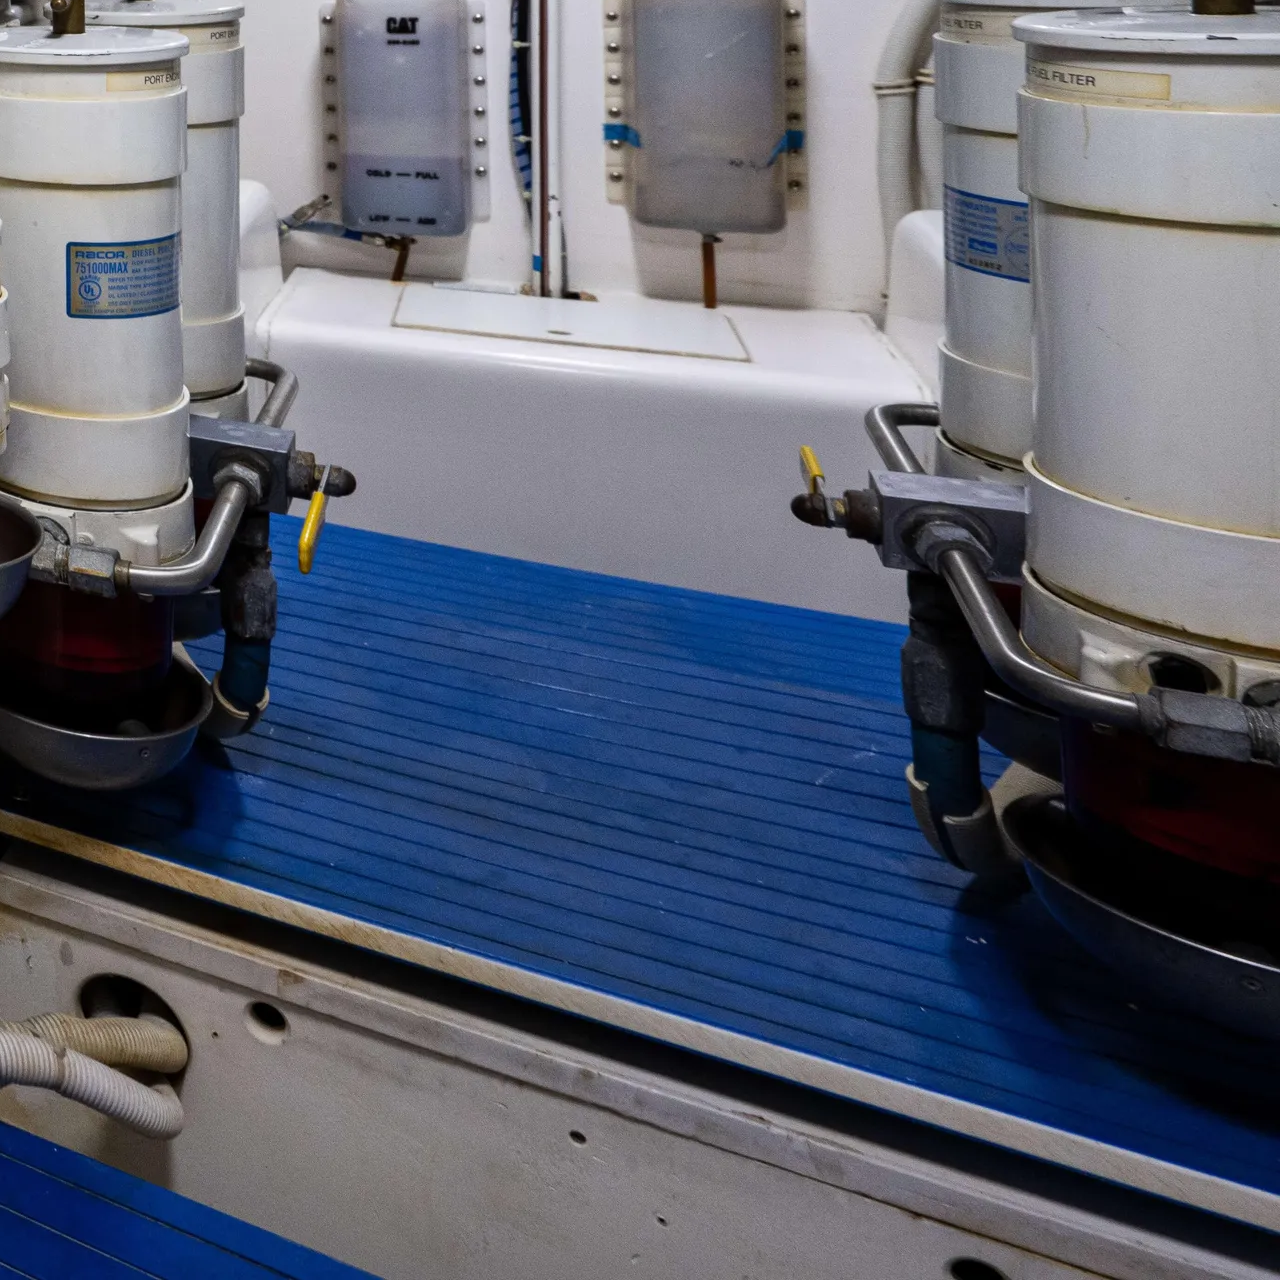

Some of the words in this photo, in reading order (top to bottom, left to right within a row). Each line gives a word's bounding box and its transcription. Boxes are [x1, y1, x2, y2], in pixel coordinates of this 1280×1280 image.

[386, 17, 419, 34] CAT
[210, 30, 227, 40] PORT
[144, 73, 165, 85] PORT
[1053, 70, 1096, 86] FILTER
[75, 262, 129, 274] 751000MAX
